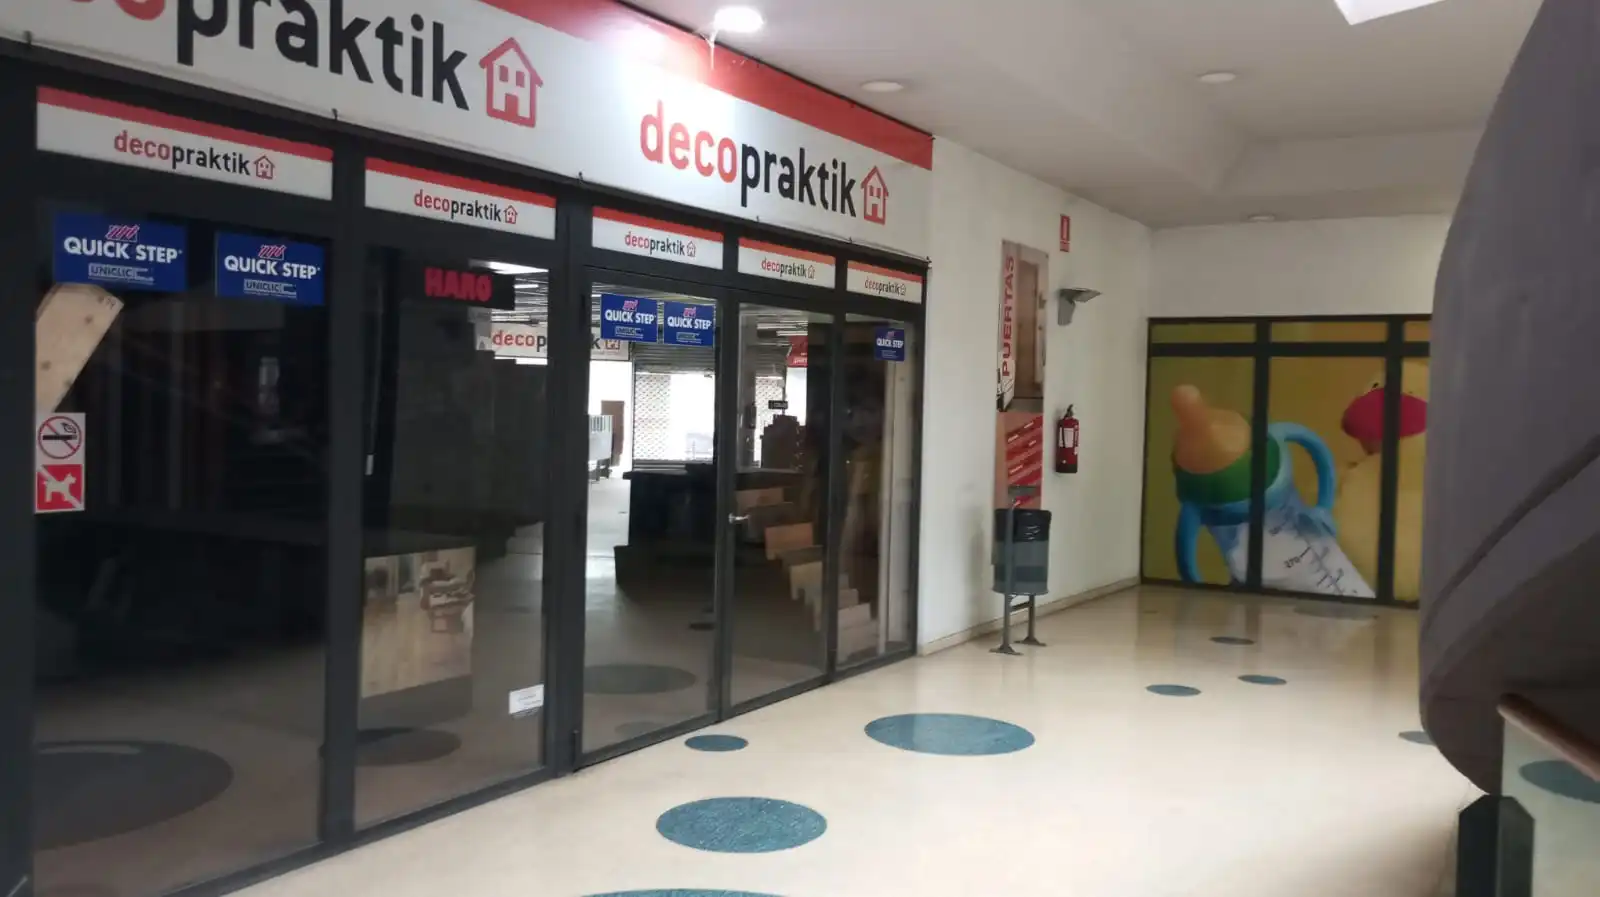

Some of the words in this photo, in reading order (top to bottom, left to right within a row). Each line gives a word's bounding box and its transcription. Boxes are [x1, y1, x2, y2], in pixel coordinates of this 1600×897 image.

[113, 129, 251, 176] decopraktik
[639, 98, 857, 218] decopraktik
[413, 188, 502, 223] decopraktik
[63, 236, 130, 260] QUICK
[135, 244, 179, 264] STEP
[624, 231, 686, 256] decopraktik
[224, 255, 278, 276] QUICK
[282, 262, 318, 279] STEP
[761, 256, 807, 279] decopraktik
[864, 276, 900, 296] decopraktik
[604, 309, 634, 323] QUICK
[635, 312, 655, 325] STEP
[667, 316, 693, 329] QUICK
[694, 319, 712, 330] STEP
[1002, 256, 1015, 377] PUERTAS
